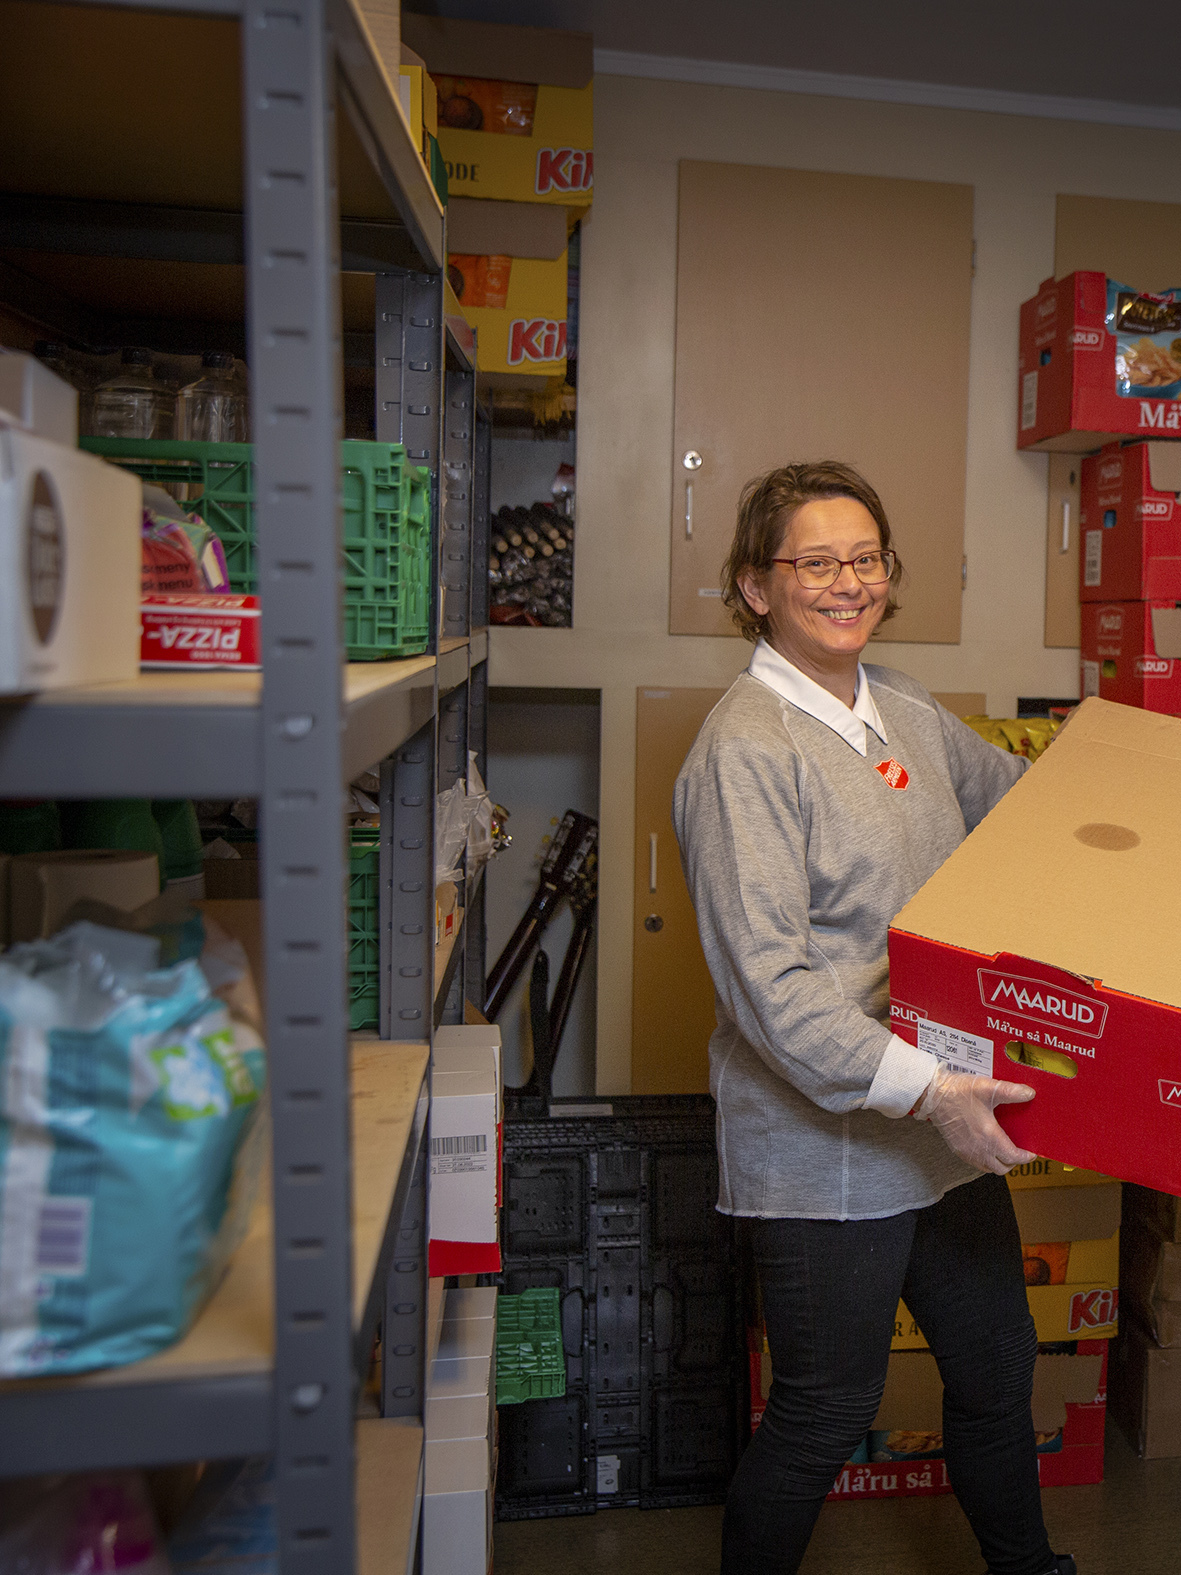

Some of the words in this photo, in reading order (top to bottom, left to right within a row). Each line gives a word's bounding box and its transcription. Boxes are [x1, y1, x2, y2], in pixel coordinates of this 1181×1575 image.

[991, 979, 1095, 1024] MAARUD
[919, 1023, 937, 1034] Maarud
[1027, 1029, 1042, 1043] så
[1043, 1033, 1096, 1059] Maarud
[906, 1463, 934, 1489] så
